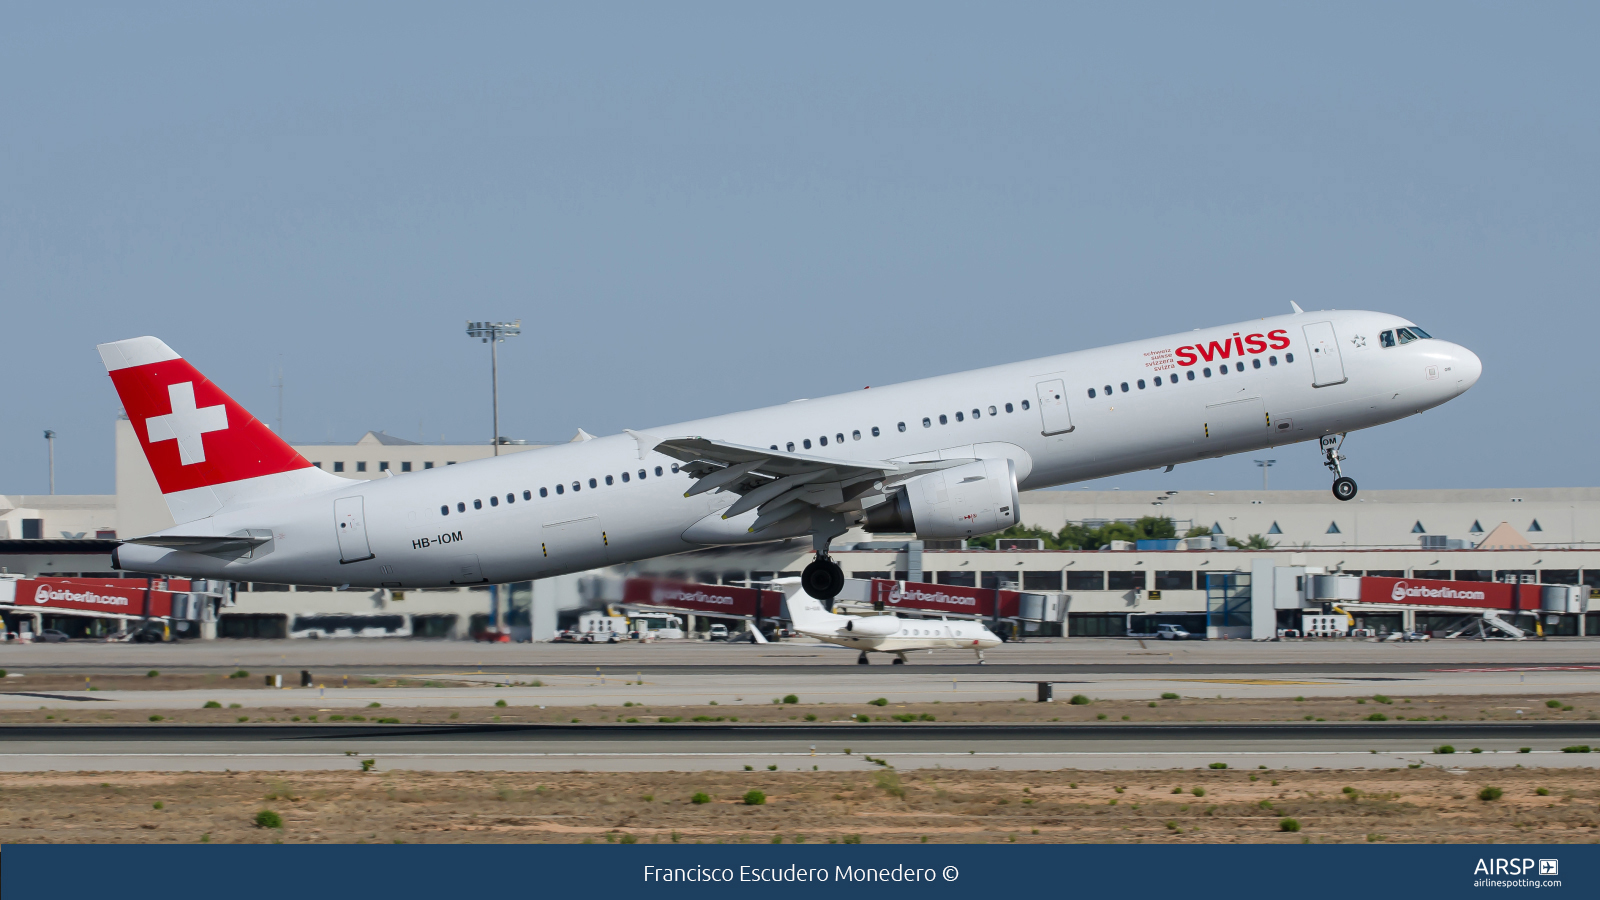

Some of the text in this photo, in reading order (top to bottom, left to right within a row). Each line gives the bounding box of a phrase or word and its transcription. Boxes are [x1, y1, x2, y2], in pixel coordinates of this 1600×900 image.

[1175, 329, 1291, 367] swiss
[1322, 437, 1337, 446] OM
[411, 530, 464, 550] HB-IOM
[49, 589, 129, 606] airberlin.com
[664, 590, 734, 605] berlin.com
[903, 589, 976, 606] airberlin.com
[1405, 585, 1485, 600] airberlin.com
